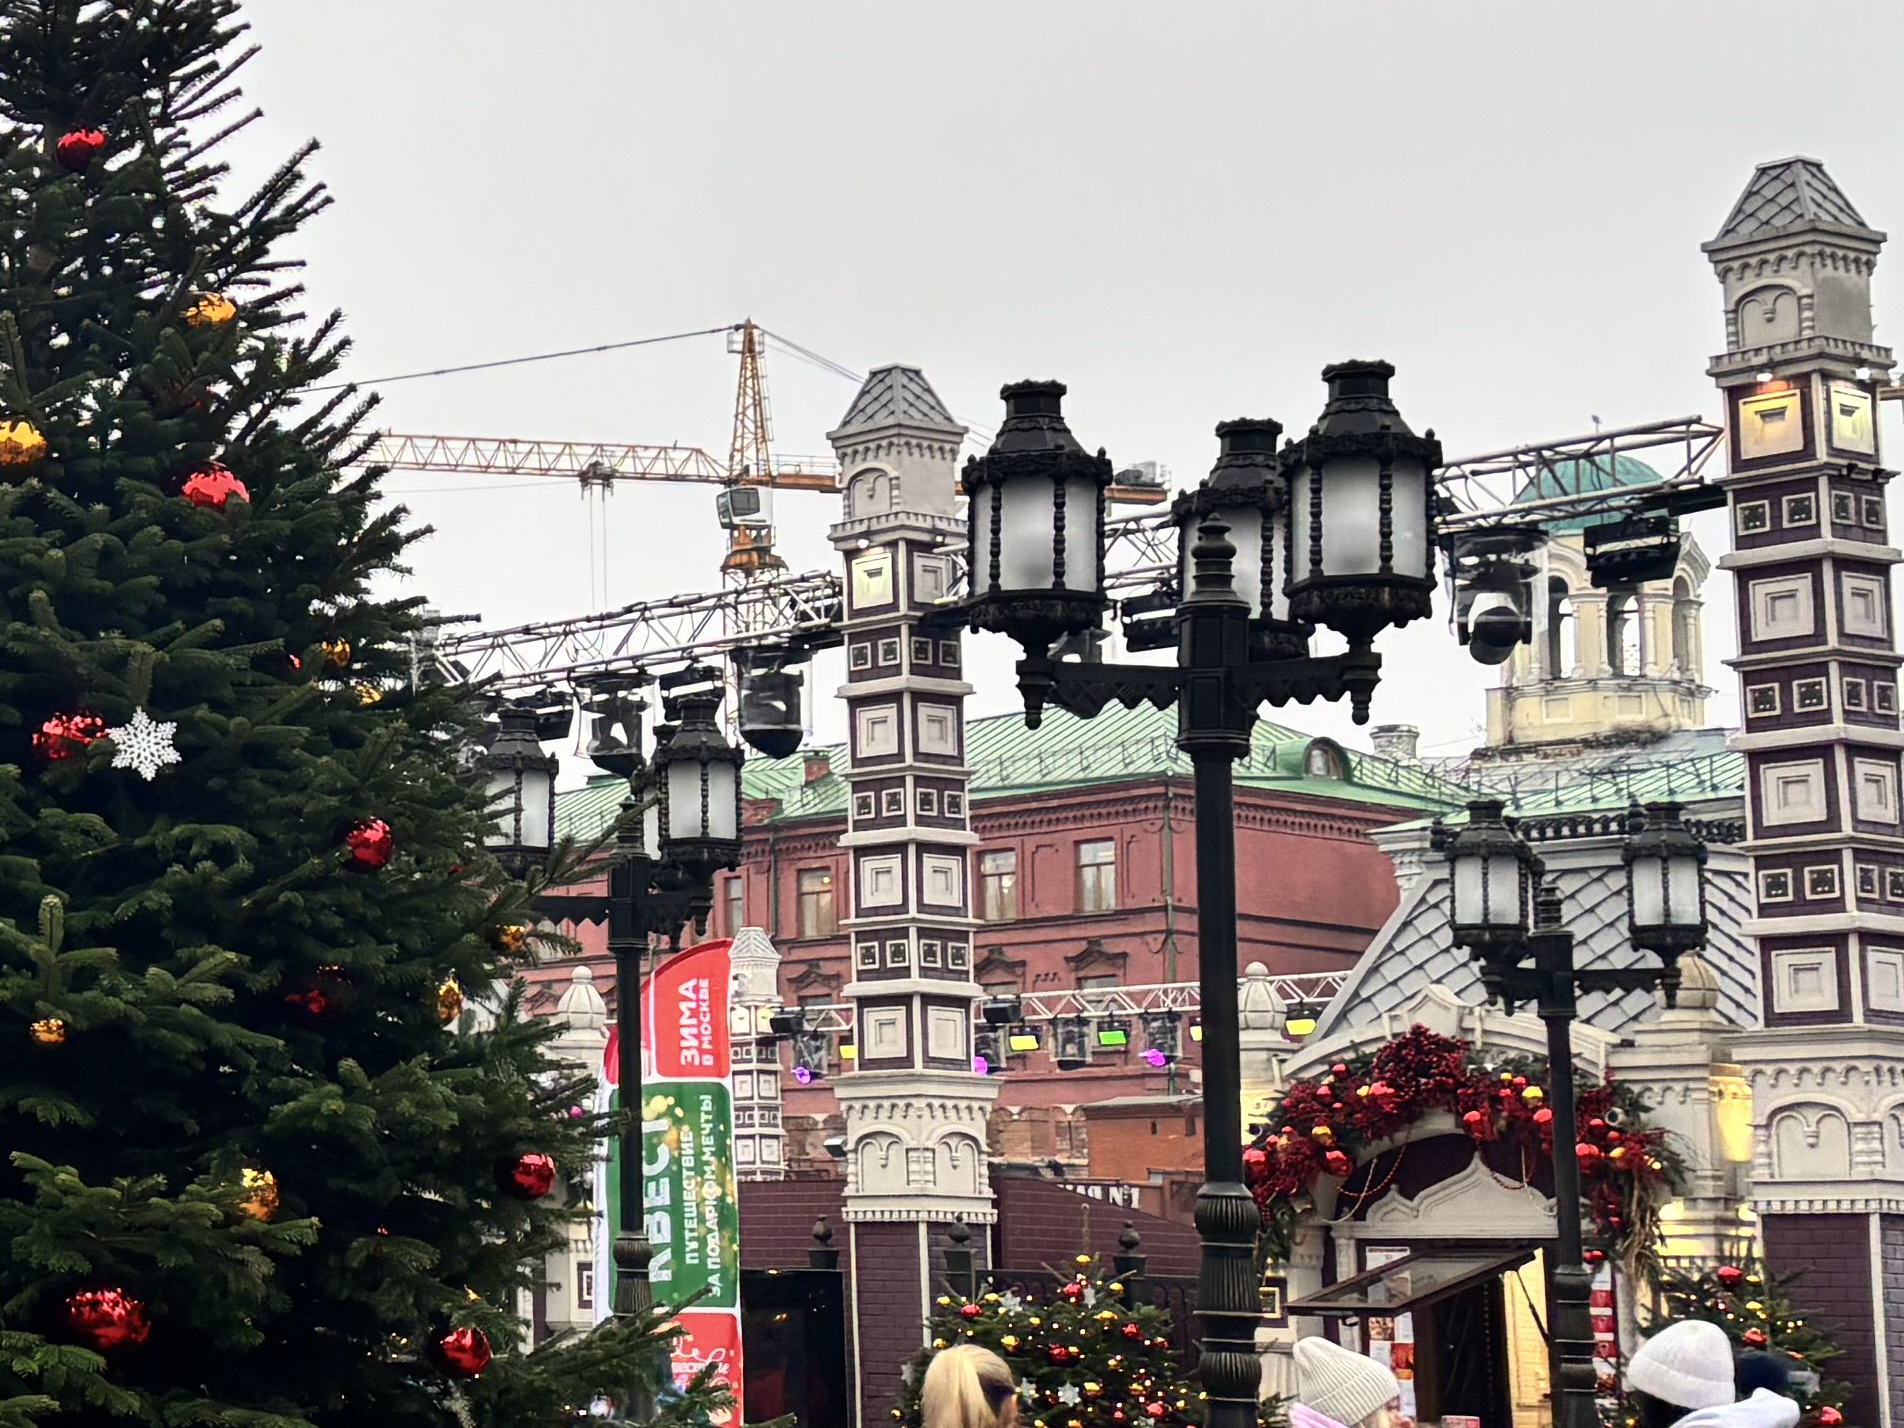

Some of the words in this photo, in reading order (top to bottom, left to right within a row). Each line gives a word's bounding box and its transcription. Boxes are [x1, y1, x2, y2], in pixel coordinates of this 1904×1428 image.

[678, 977, 700, 1066] ЗИМА
[698, 978, 713, 1049] МОСКВЕ
[701, 1054, 714, 1066] В
[699, 1095, 716, 1161] МЕЧТЫ
[680, 1131, 700, 1264] ПУТЕШЕСТВИЕ
[702, 1165, 721, 1269] ПОДАРКОМ
